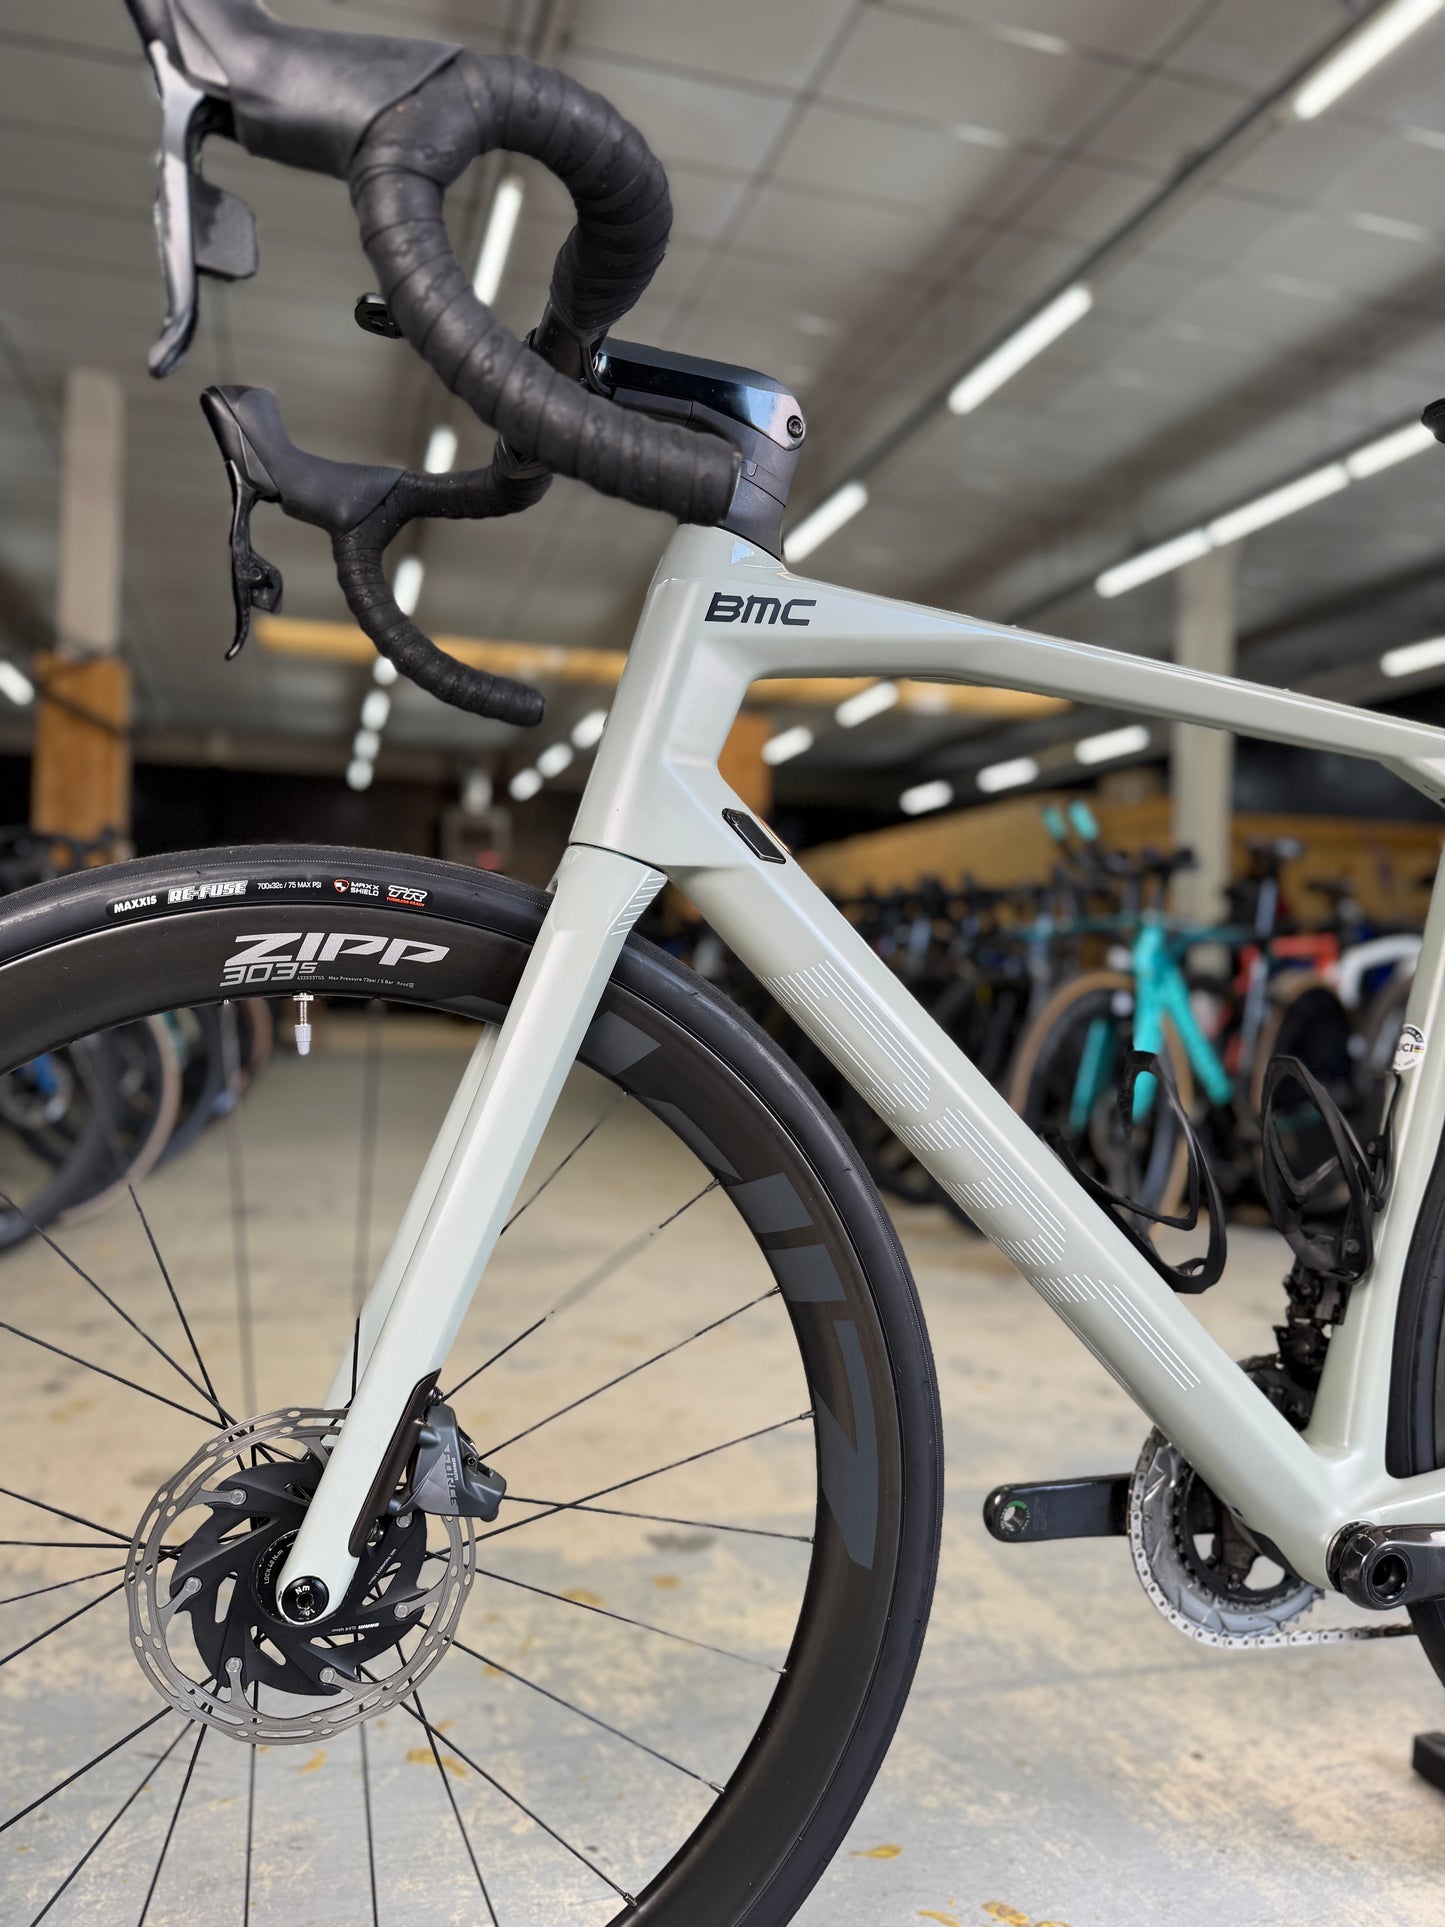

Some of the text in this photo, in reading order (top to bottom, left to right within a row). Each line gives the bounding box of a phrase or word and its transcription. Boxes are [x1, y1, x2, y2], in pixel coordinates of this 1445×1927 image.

[704, 592, 817, 626] BMC
[167, 880, 249, 904] RE-FUSE
[288, 881, 297, 889] 75
[350, 887, 379, 896] SHIELD
[351, 881, 380, 891] MAXX
[388, 885, 428, 902] TR
[113, 895, 158, 914] MAXXIS
[224, 932, 450, 967] ZIPP
[444, 1451, 458, 1506] FORCE
[264, 1568, 272, 1585] LOCK
